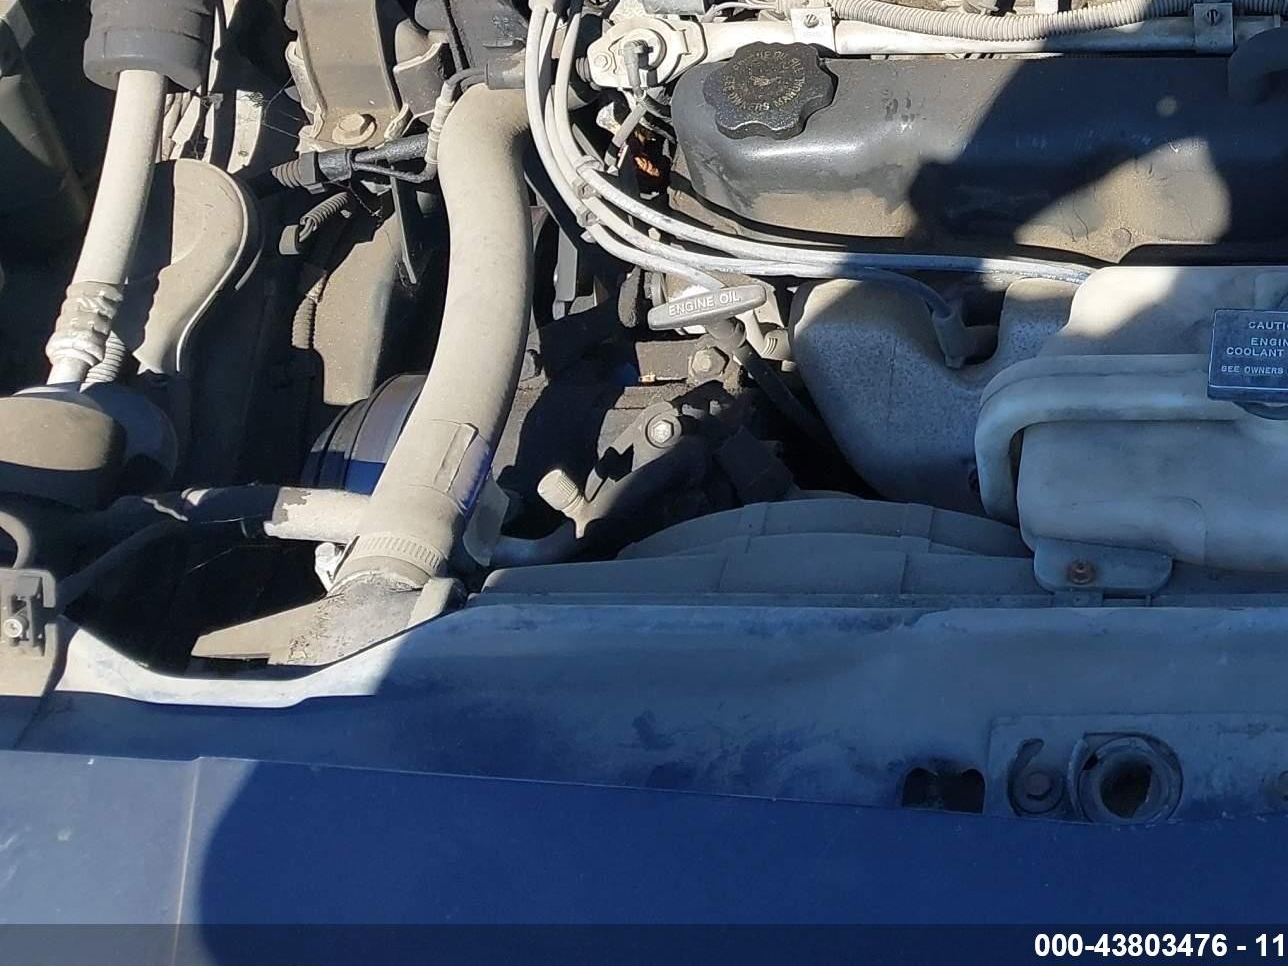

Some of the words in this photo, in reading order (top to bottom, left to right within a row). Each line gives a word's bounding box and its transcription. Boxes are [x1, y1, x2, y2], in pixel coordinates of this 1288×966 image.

[668, 295, 715, 316] ENGINE
[719, 291, 740, 305] OIL
[1226, 346, 1285, 357] COOLANT
[1221, 365, 1240, 373] SEE
[1244, 365, 1284, 375] OWNERS
